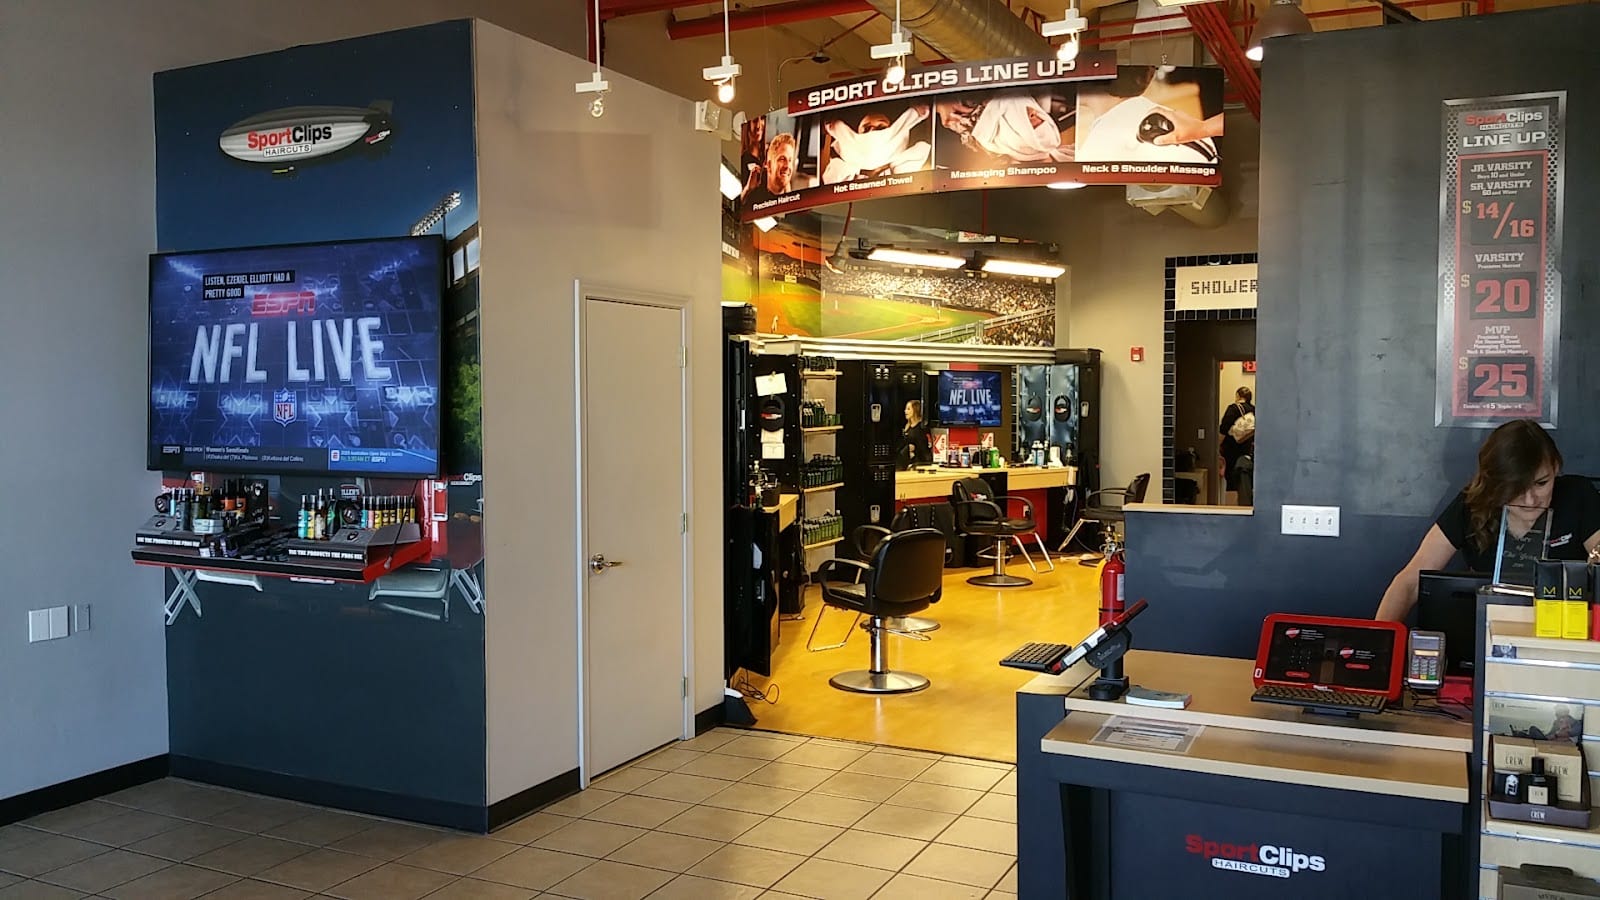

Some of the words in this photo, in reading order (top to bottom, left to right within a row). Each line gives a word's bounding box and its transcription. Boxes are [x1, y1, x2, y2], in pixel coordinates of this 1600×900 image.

[807, 80, 877, 107] SPORT
[882, 69, 958, 94] CLIPS
[965, 62, 1029, 83] LINE
[1036, 59, 1076, 77] UP
[247, 125, 332, 151] SportClips
[1463, 133, 1512, 148] LINE
[1517, 131, 1546, 145] UP
[264, 144, 311, 157] HAIRCUTS
[951, 168, 1006, 180] Massaging
[1007, 165, 1057, 176] Shampoo
[1082, 164, 1110, 174] Neck
[1111, 164, 1120, 174] &
[1121, 164, 1167, 174] Shoulder
[1169, 165, 1215, 176] Massage
[1487, 161, 1533, 172] VARSITY
[833, 184, 849, 194] Hot
[849, 178, 886, 192] Steamed
[887, 175, 913, 186] Towel
[1486, 179, 1533, 190] VARSITY
[752, 199, 778, 211] Precision
[777, 193, 800, 206] Haircut
[1474, 252, 1525, 263] VARSITY
[249, 273, 272, 284] ELLIOTT
[285, 271, 291, 281] A
[204, 288, 226, 299] PRETTY
[226, 287, 242, 297] GOOD
[1191, 279, 1258, 295] SHOWER
[251, 290, 316, 316] ESPN
[1475, 279, 1531, 313] 20
[1484, 325, 1511, 335] MVP
[188, 322, 268, 384] NFL
[287, 316, 392, 382] LIVE
[1472, 363, 1528, 398] 25
[949, 389, 968, 405] NFL
[971, 388, 993, 405] LIVE
[276, 402, 295, 419] NFL
[1543, 586, 1557, 595] M
[1568, 587, 1583, 596] M
[1505, 756, 1523, 766] CREW
[1549, 765, 1569, 776] CREW
[1530, 811, 1546, 819] CREW
[1185, 834, 1326, 872] SportClips
[1214, 859, 1289, 877] HAIRCUTS
